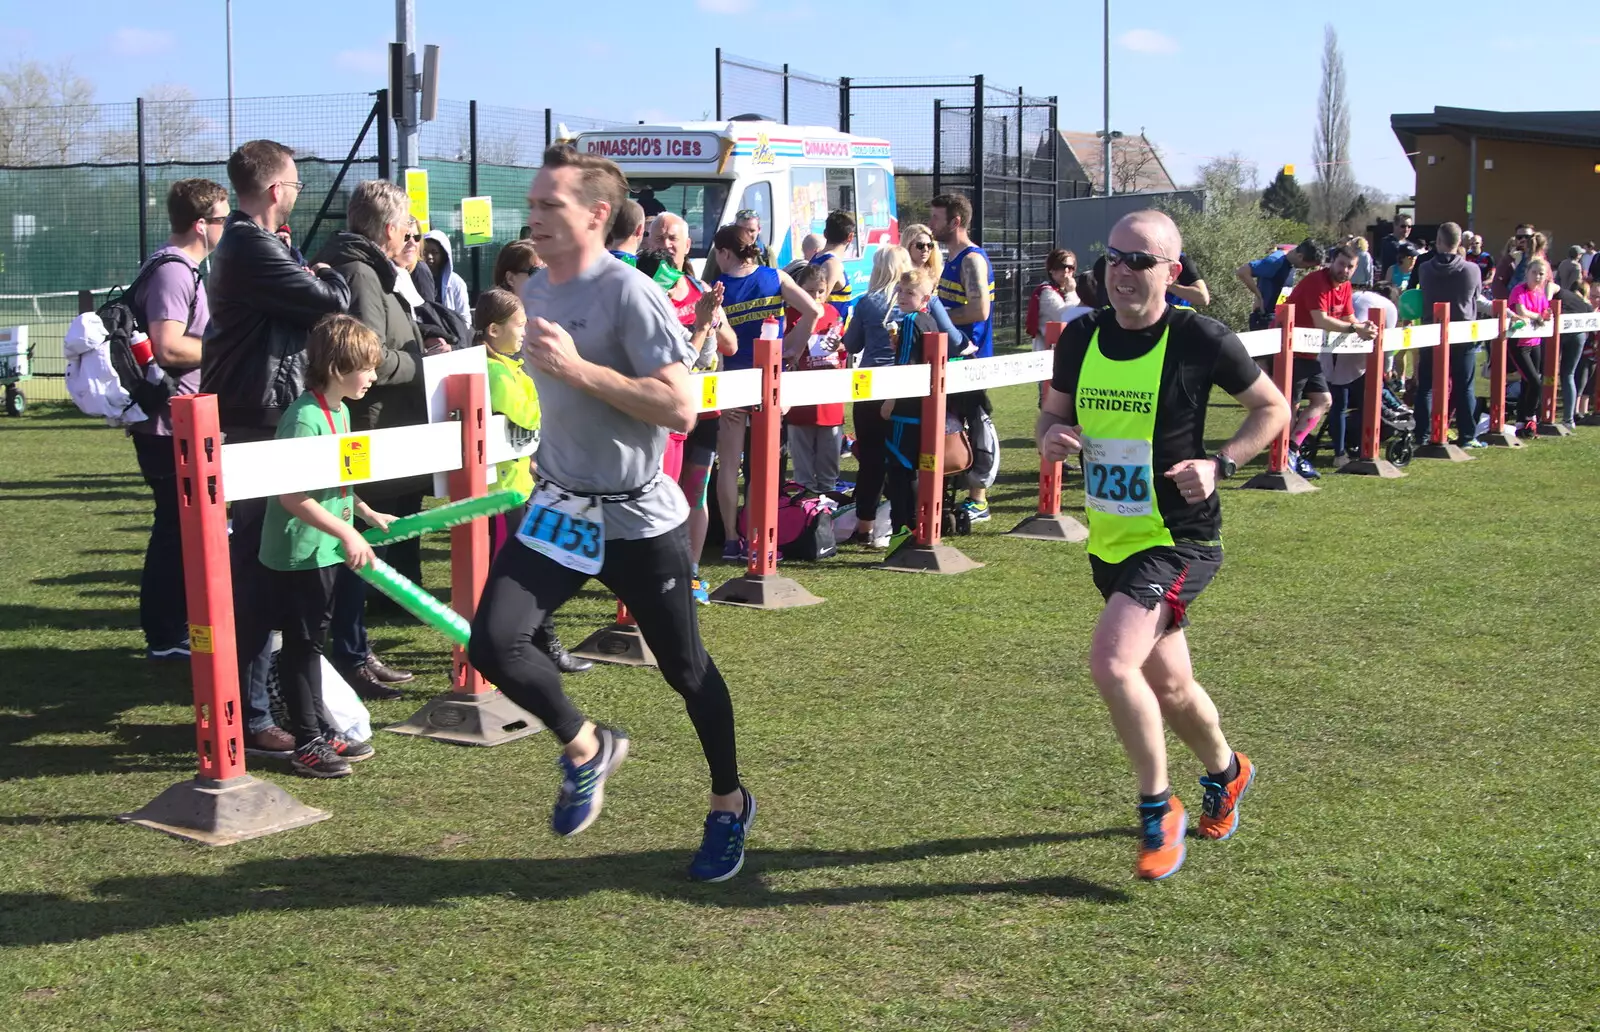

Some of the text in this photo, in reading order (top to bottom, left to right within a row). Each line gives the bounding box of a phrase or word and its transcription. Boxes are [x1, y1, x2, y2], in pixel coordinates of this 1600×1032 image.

[587, 137, 702, 157] DIMASCIO'S ICES
[804, 140, 849, 157] DIMASCIO'S
[1080, 387, 1154, 400] STOWMARKET
[1079, 397, 1152, 414] STRIDERS
